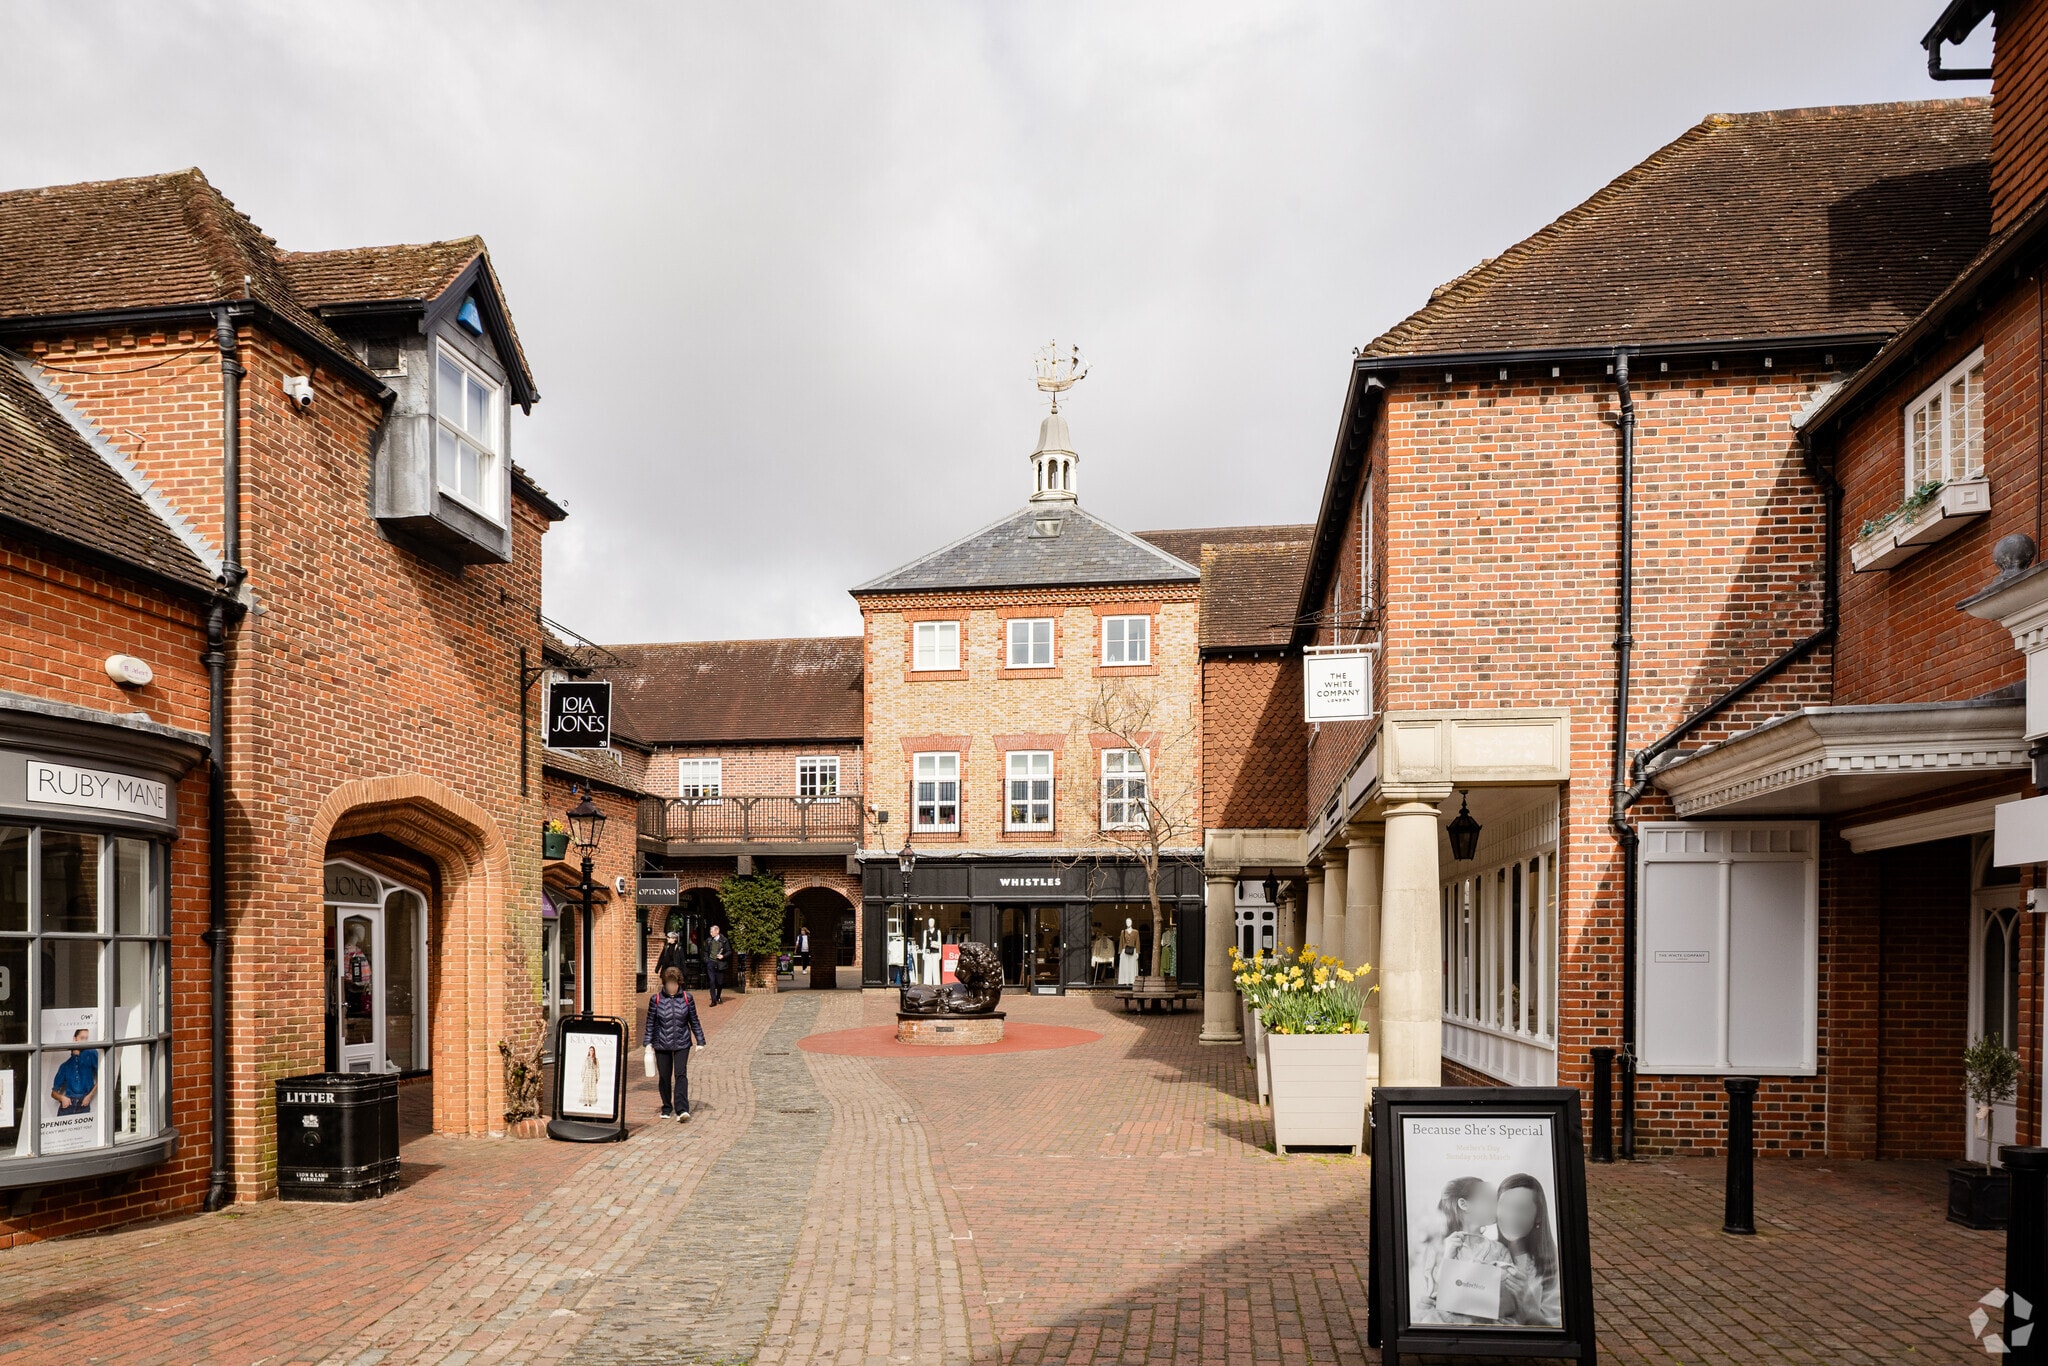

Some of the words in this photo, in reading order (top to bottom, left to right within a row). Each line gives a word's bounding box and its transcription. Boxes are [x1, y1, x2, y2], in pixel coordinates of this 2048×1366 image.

[1317, 689, 1360, 697] COMPANY
[562, 697, 596, 714] LOLA
[552, 715, 605, 733] JONES
[40, 768, 110, 799] RUBY
[118, 779, 163, 809] MANE
[332, 876, 372, 897] JONES
[1000, 878, 1062, 887] WHISTLES
[638, 888, 677, 896] OPTICIANS
[286, 1092, 335, 1103] LITTER
[40, 1120, 73, 1129] OPENING
[74, 1116, 94, 1125] SOON
[1412, 1124, 1461, 1135] Because
[1464, 1124, 1496, 1135] She's
[1499, 1125, 1543, 1139] Special
[1446, 1153, 1471, 1161] Sunday
